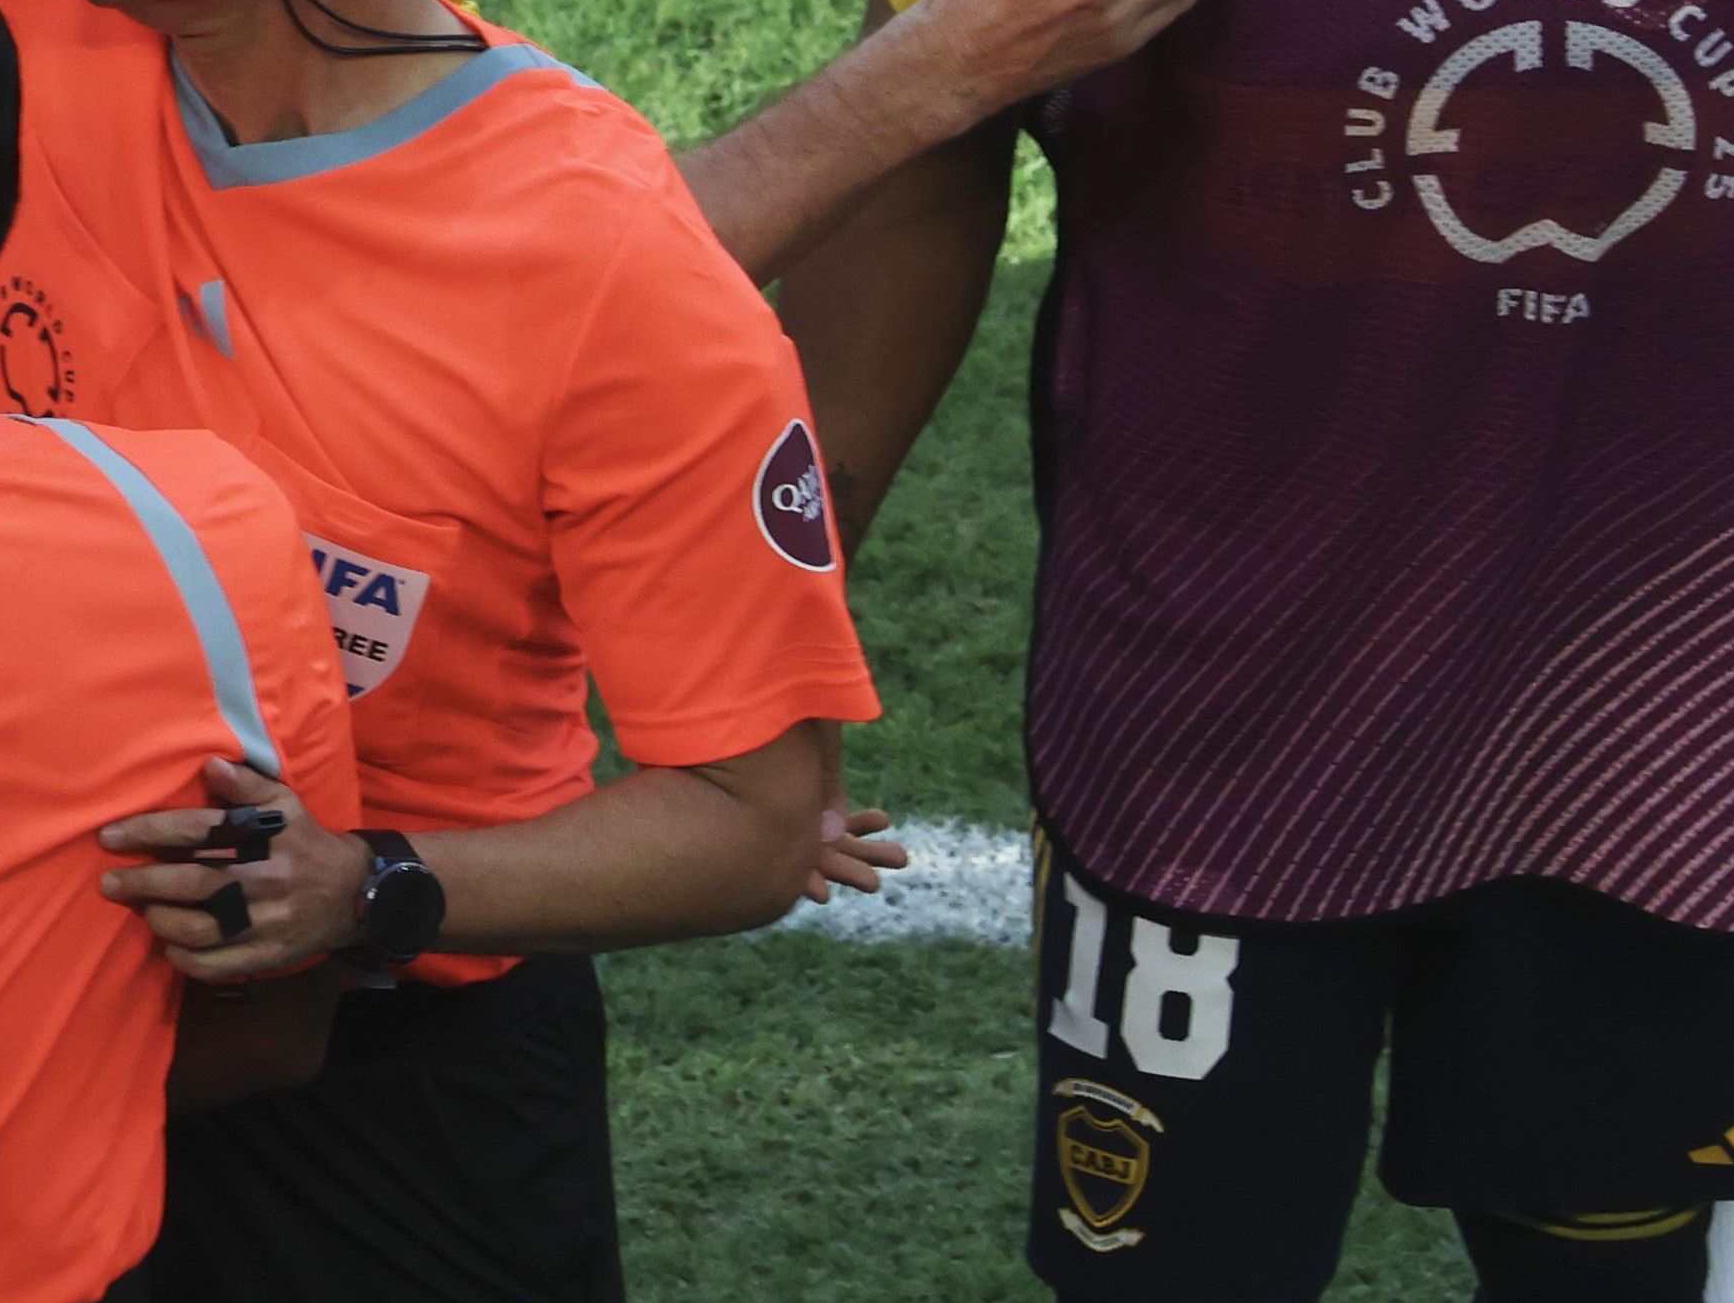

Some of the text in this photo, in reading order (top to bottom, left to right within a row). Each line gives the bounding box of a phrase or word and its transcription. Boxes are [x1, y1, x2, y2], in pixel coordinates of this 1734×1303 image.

[1343, 66, 1400, 210] CLUB
[1496, 286, 1591, 324] FIFA
[1047, 872, 1241, 1081] 18
[1070, 1142, 1131, 1180] CABJ
